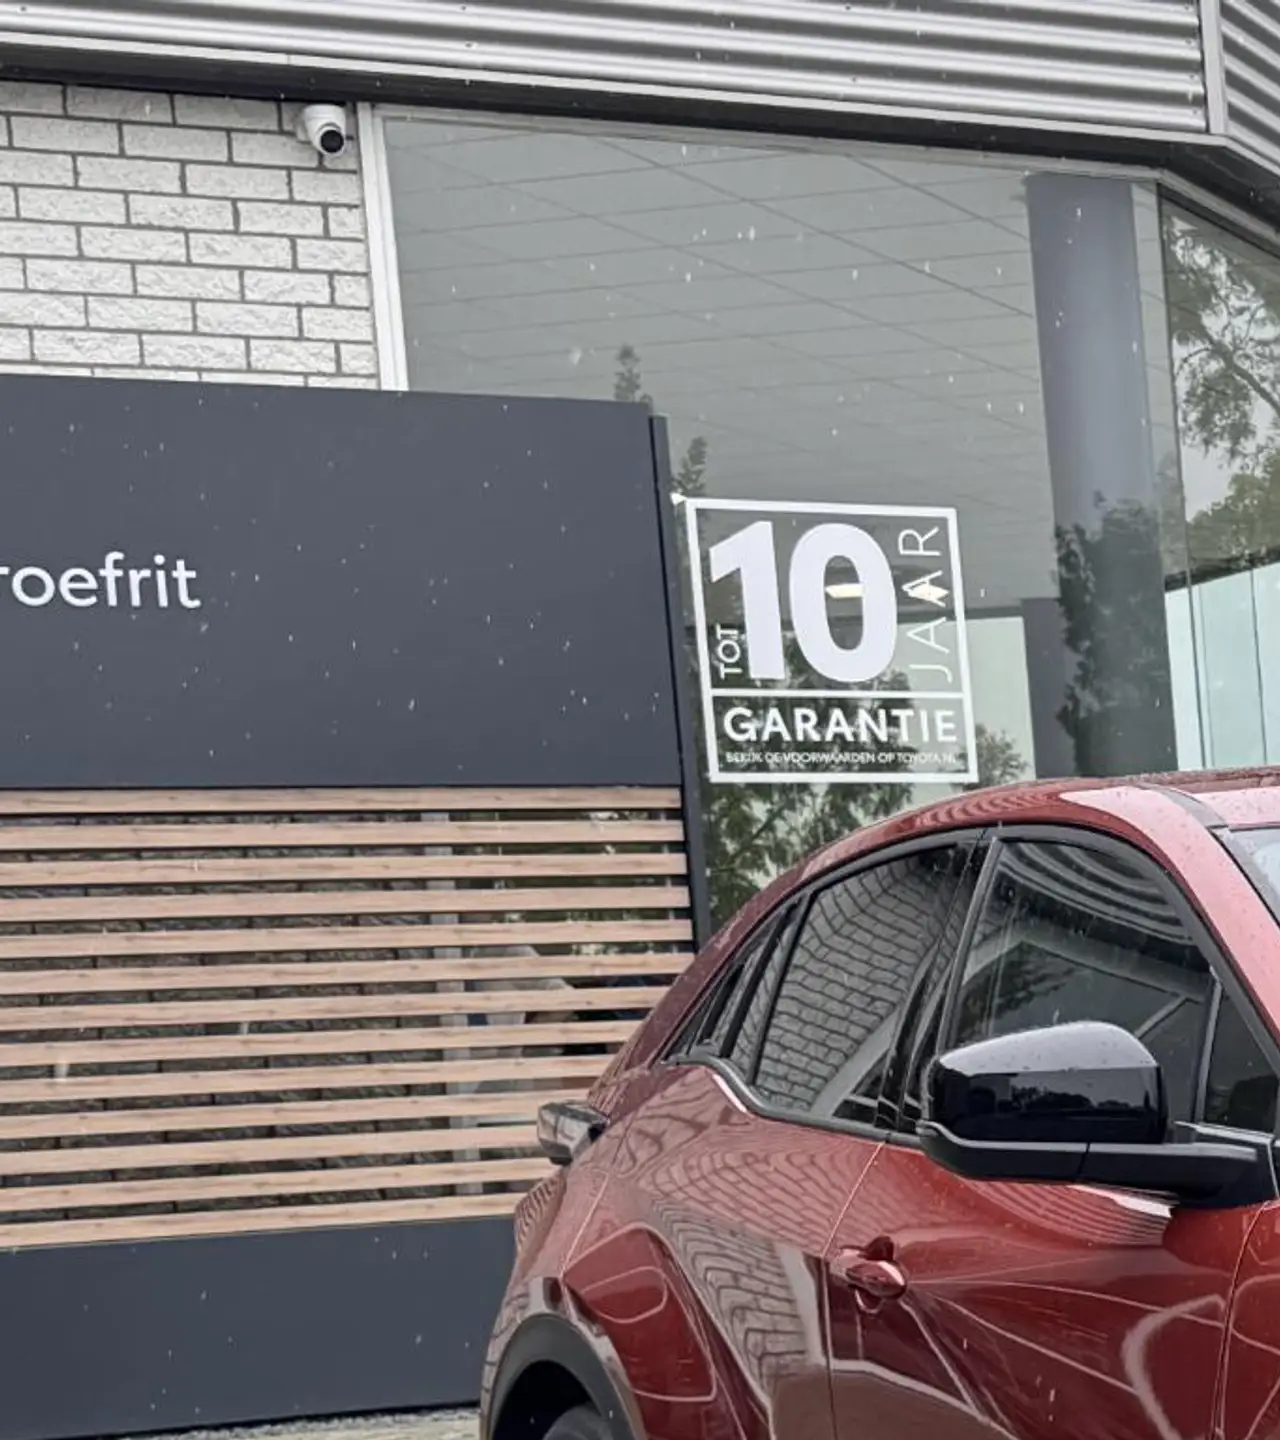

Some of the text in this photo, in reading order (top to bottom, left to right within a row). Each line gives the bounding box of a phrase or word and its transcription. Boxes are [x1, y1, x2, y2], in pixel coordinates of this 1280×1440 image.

[708, 519, 898, 684] 10
[715, 622, 744, 680] TOT
[897, 525, 954, 684] JAAR
[723, 706, 958, 743] GARANTIE
